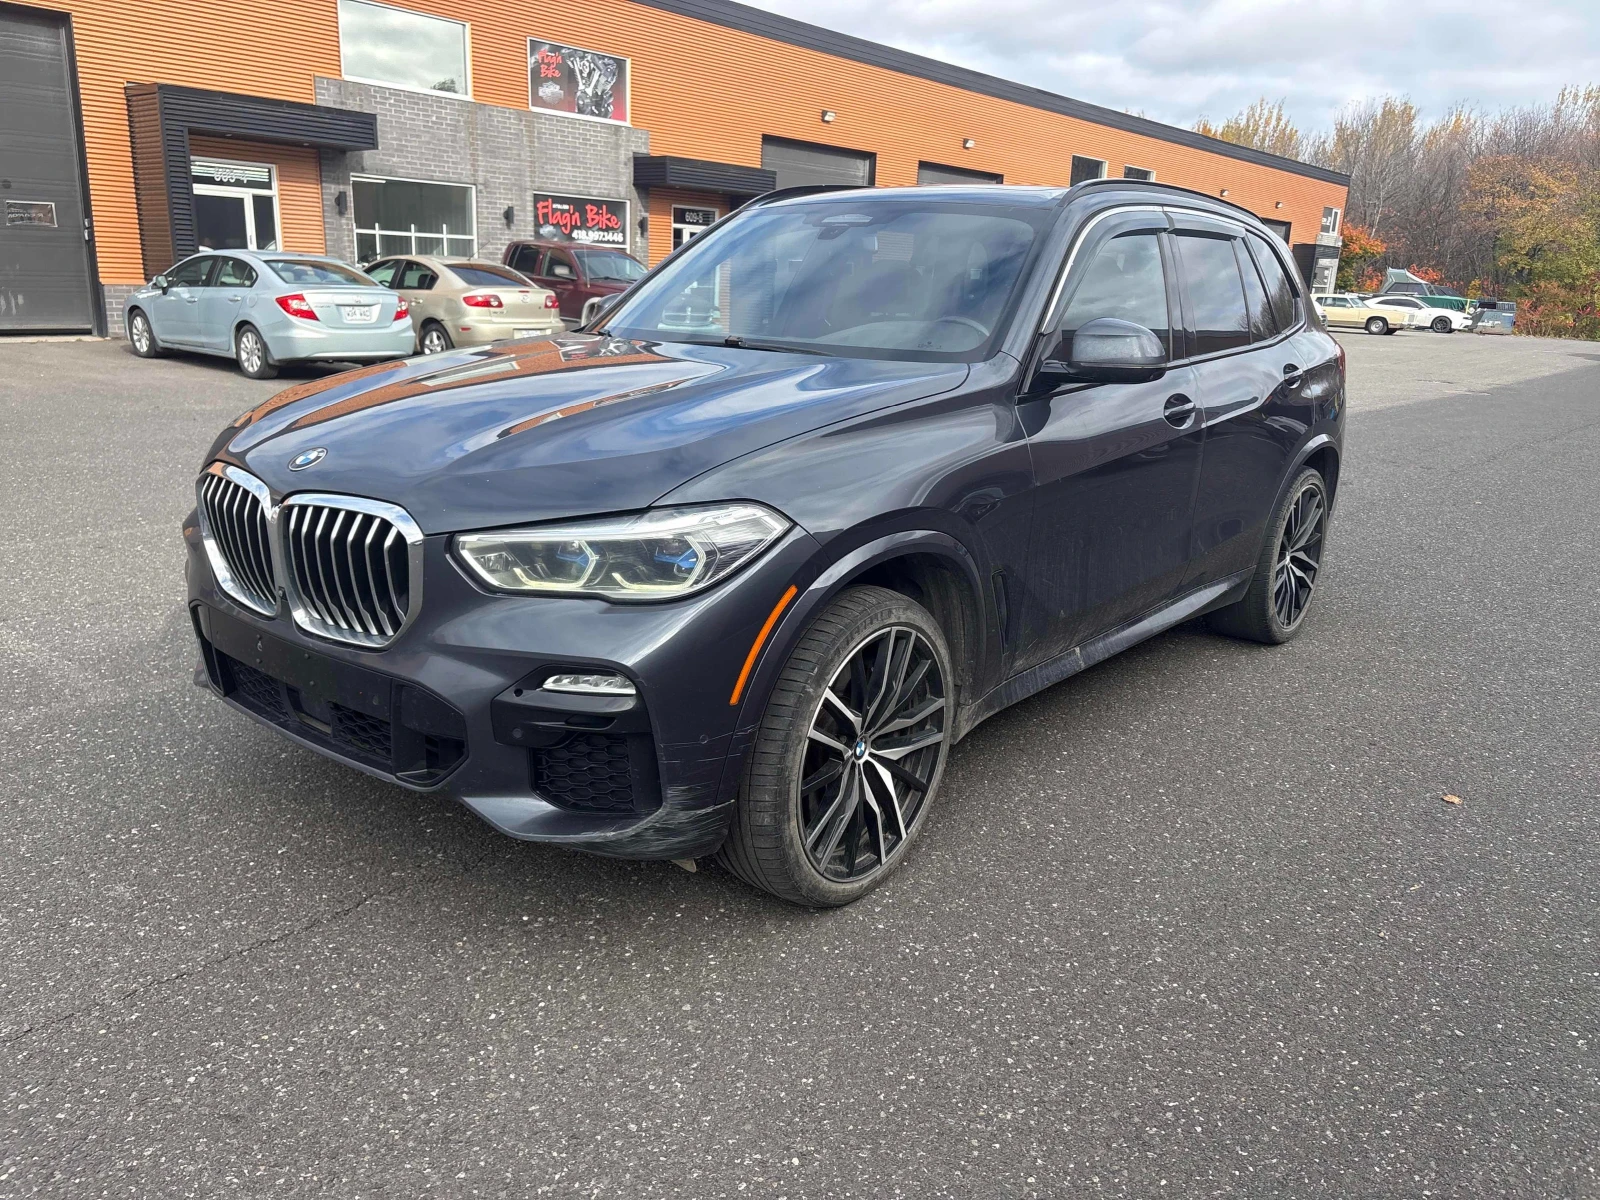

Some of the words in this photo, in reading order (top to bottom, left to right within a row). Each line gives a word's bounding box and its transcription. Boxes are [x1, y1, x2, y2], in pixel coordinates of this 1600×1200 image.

[540, 64, 561, 77] Bike
[536, 198, 581, 234] Flag'n
[585, 203, 621, 229] Bike
